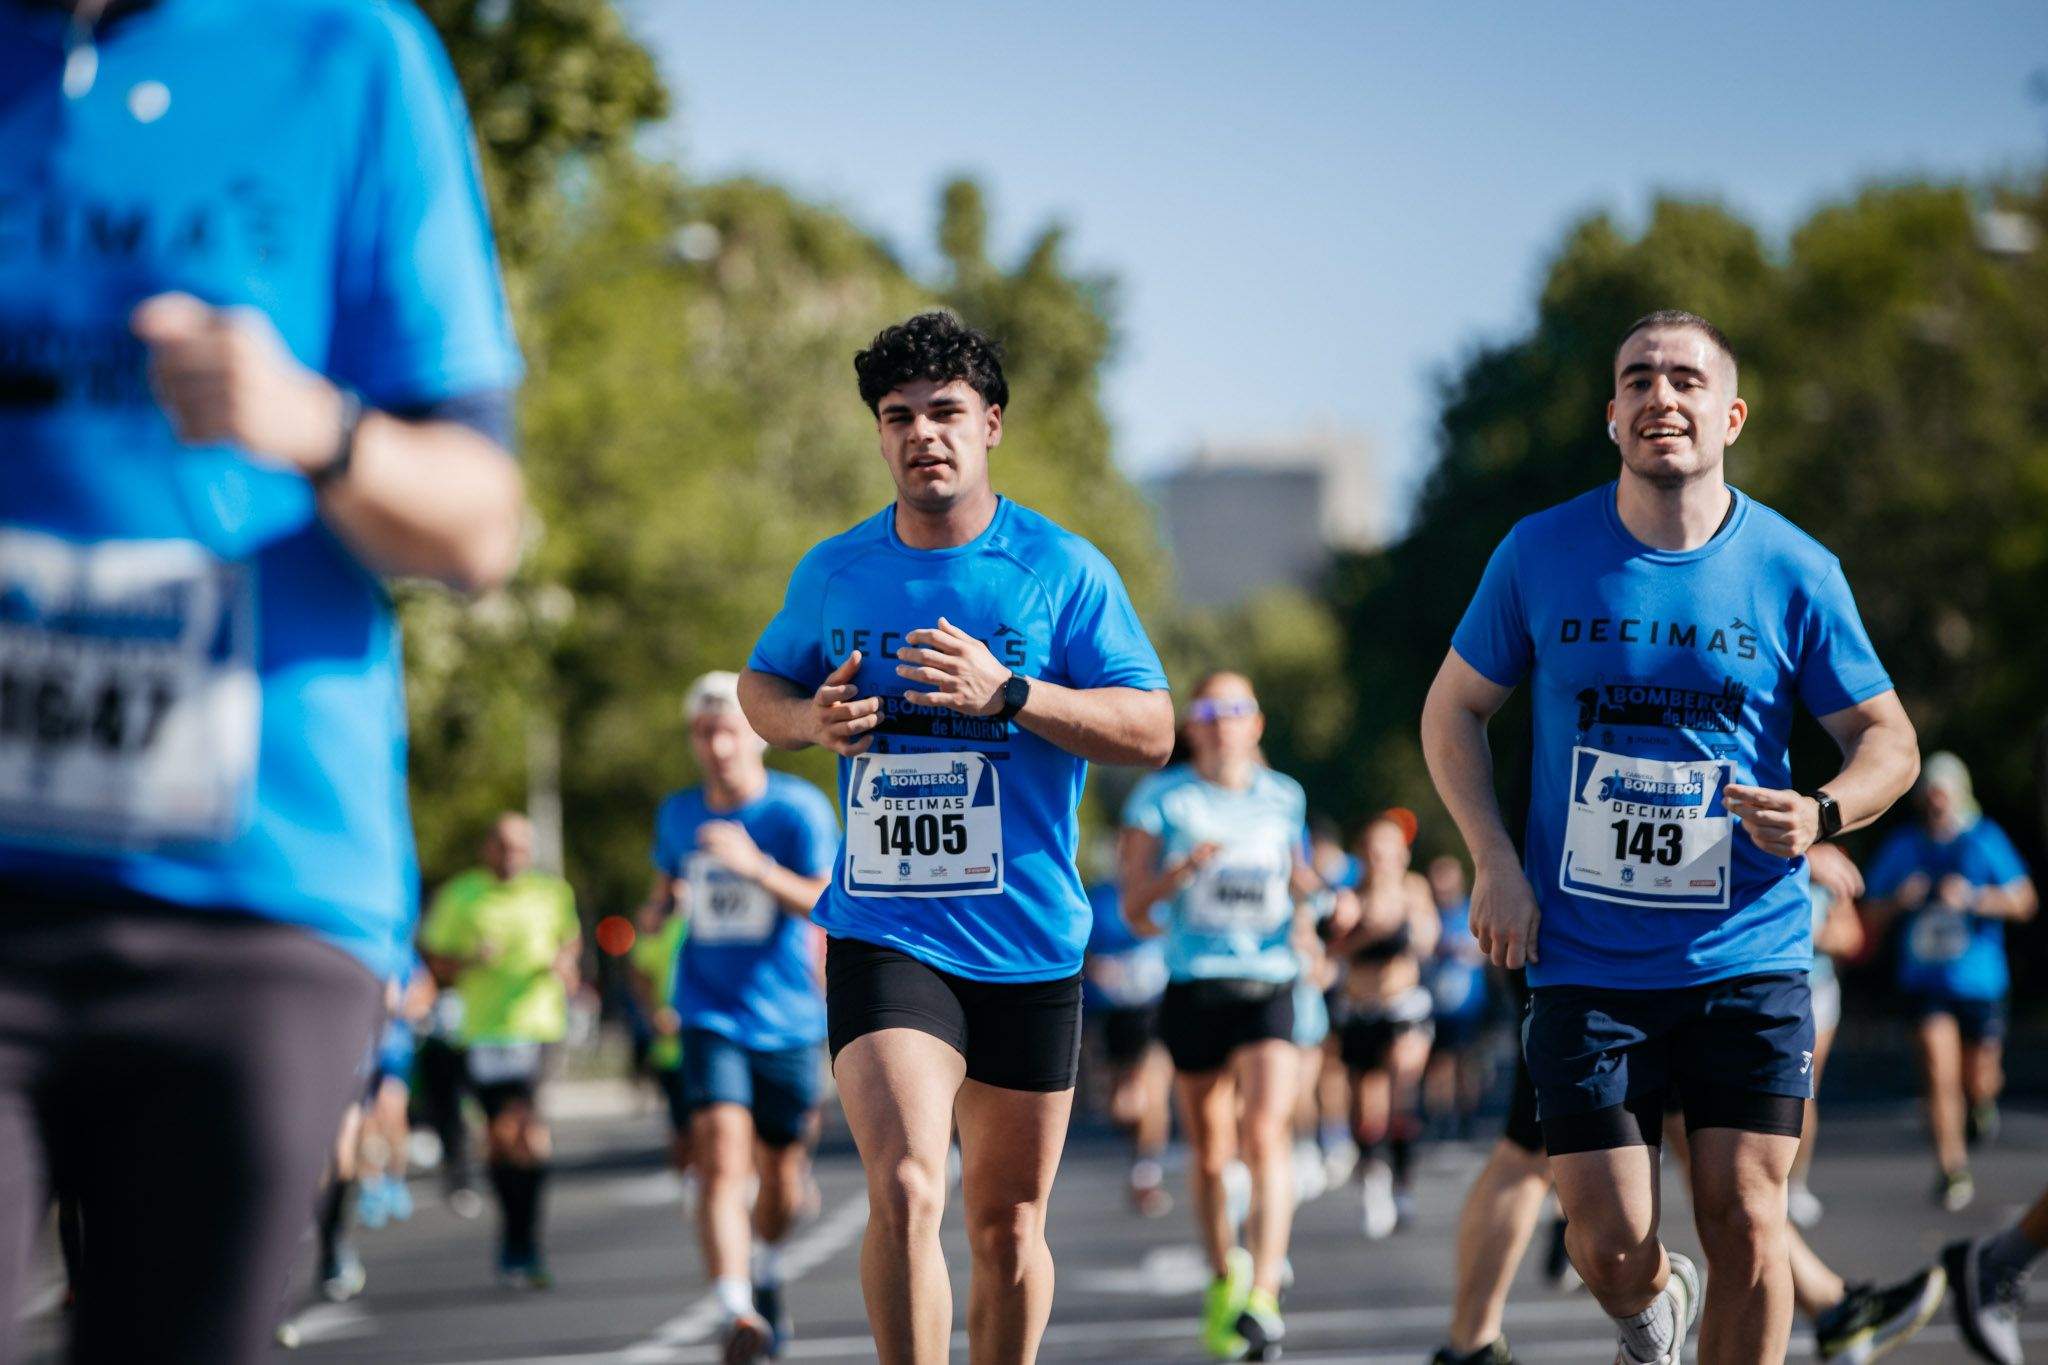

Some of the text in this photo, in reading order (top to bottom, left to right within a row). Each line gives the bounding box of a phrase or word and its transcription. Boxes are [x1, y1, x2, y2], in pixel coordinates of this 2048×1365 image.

[831, 629, 1028, 667] DECS
[1560, 618, 1758, 661] DECIMAS
[931, 719, 1006, 739] de MADRID
[890, 773, 965, 786] BOMBEROS
[1624, 778, 1702, 795] BOMBEROS
[884, 798, 965, 811] DECIMAS
[1613, 801, 1699, 820] DECIMAS
[874, 813, 968, 856] 1405
[1611, 818, 1684, 867] 143
